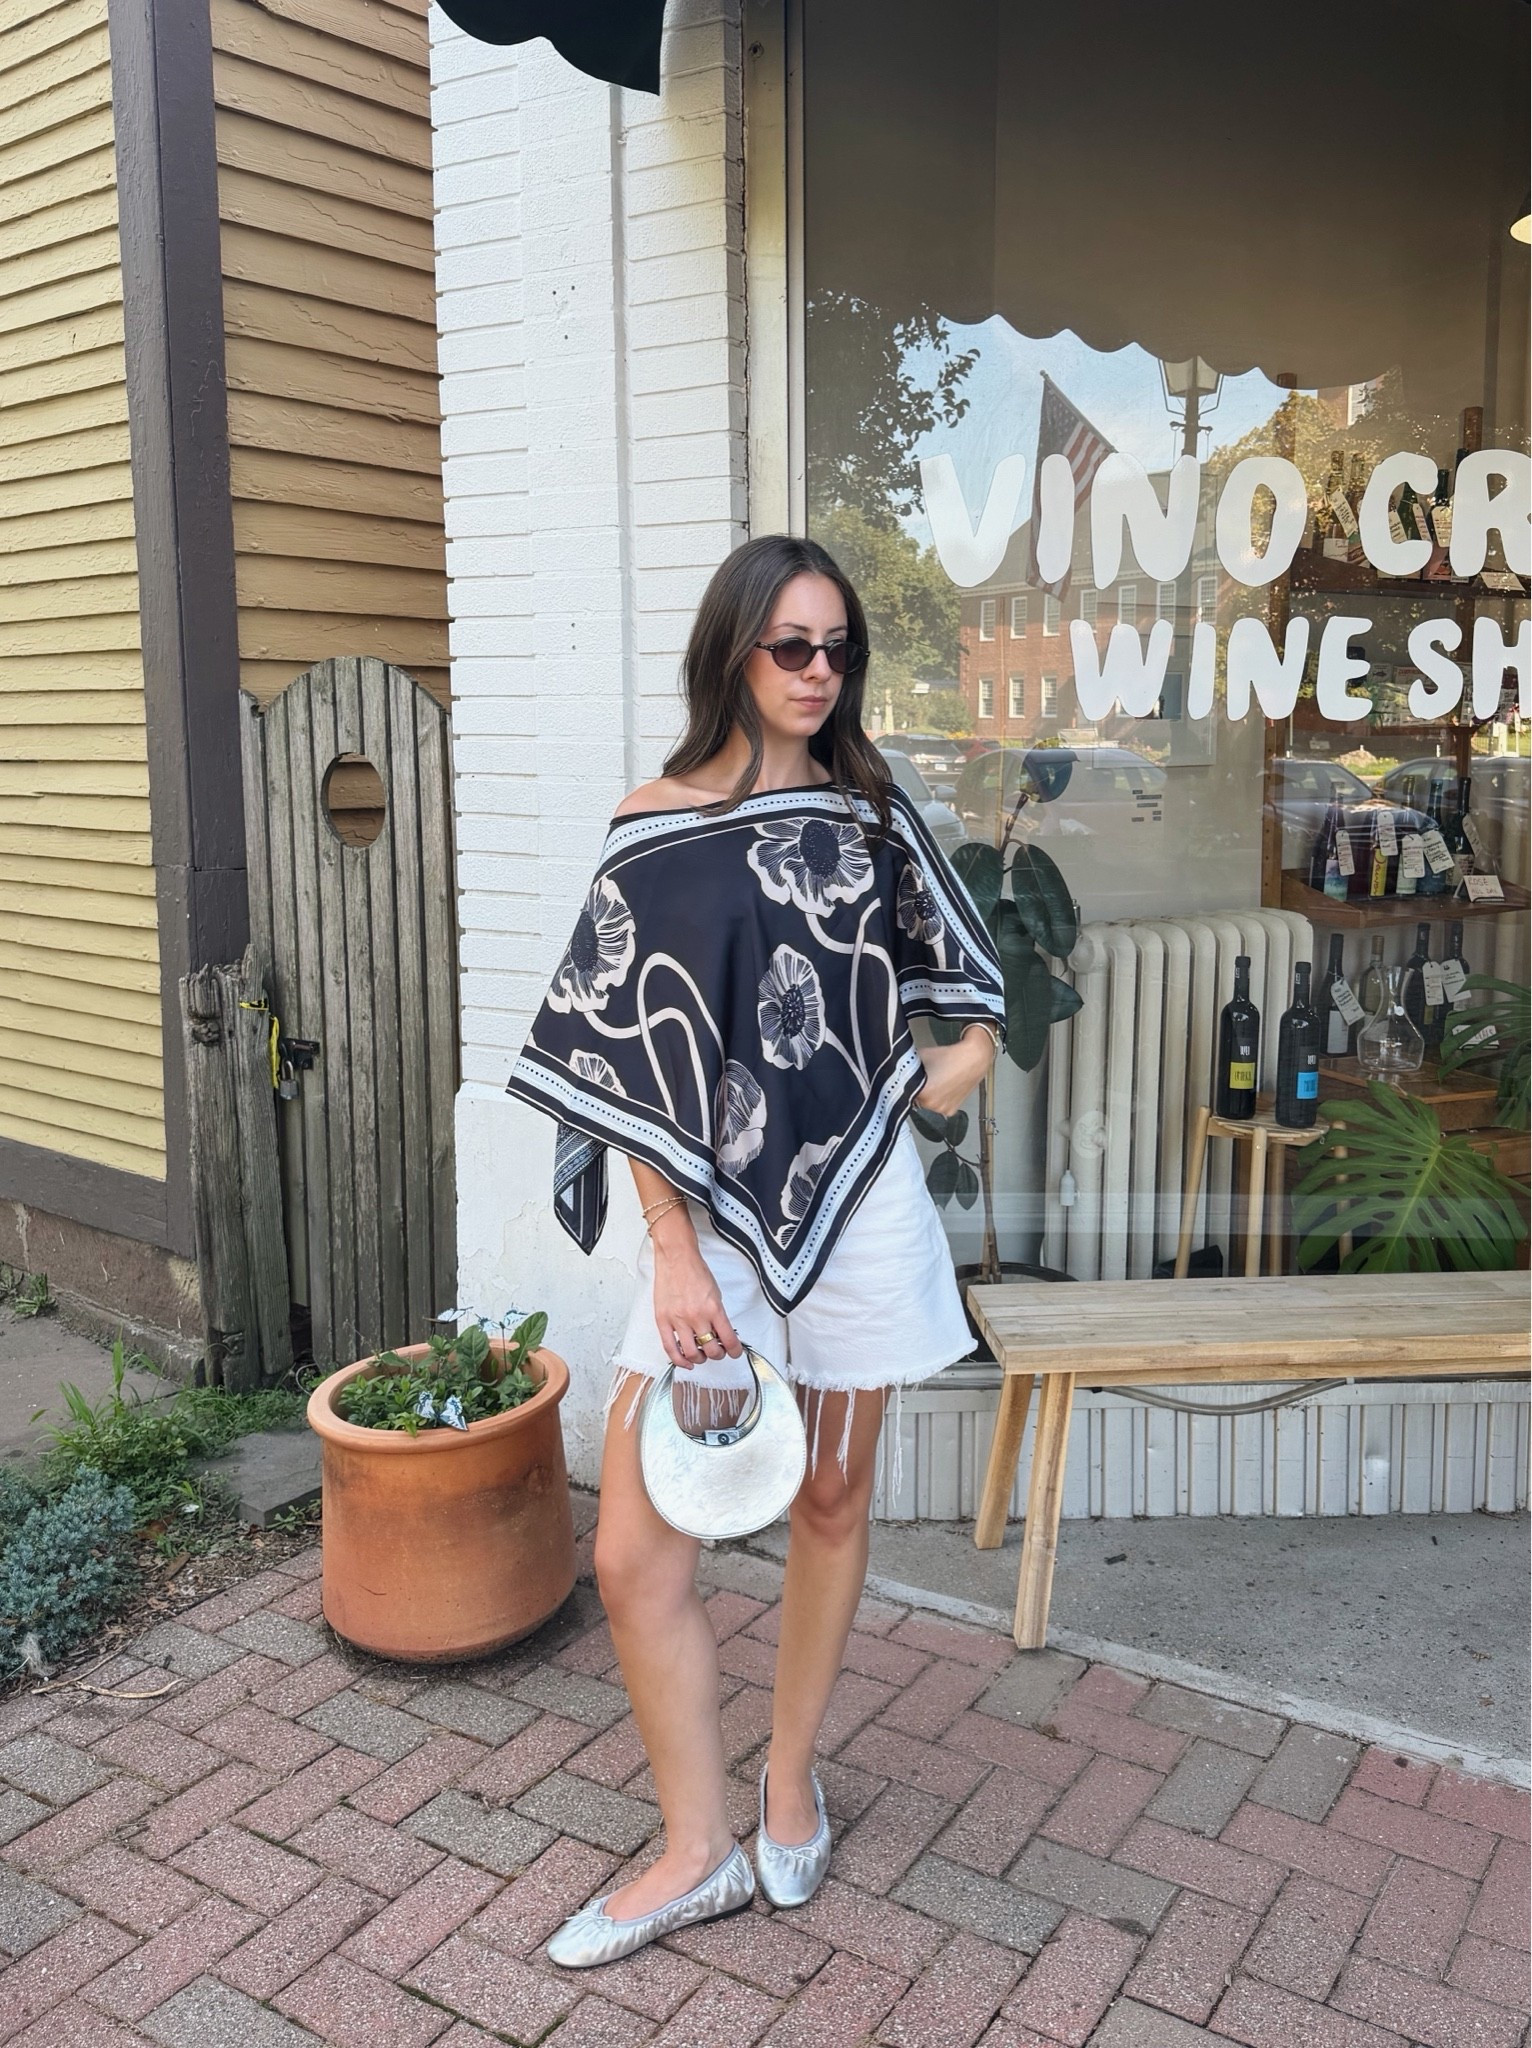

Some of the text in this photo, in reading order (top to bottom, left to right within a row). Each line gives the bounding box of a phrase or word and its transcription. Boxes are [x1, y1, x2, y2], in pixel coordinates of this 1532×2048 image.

[920, 449, 1531, 589] VINO CR
[1070, 616, 1531, 722] WINE SH
